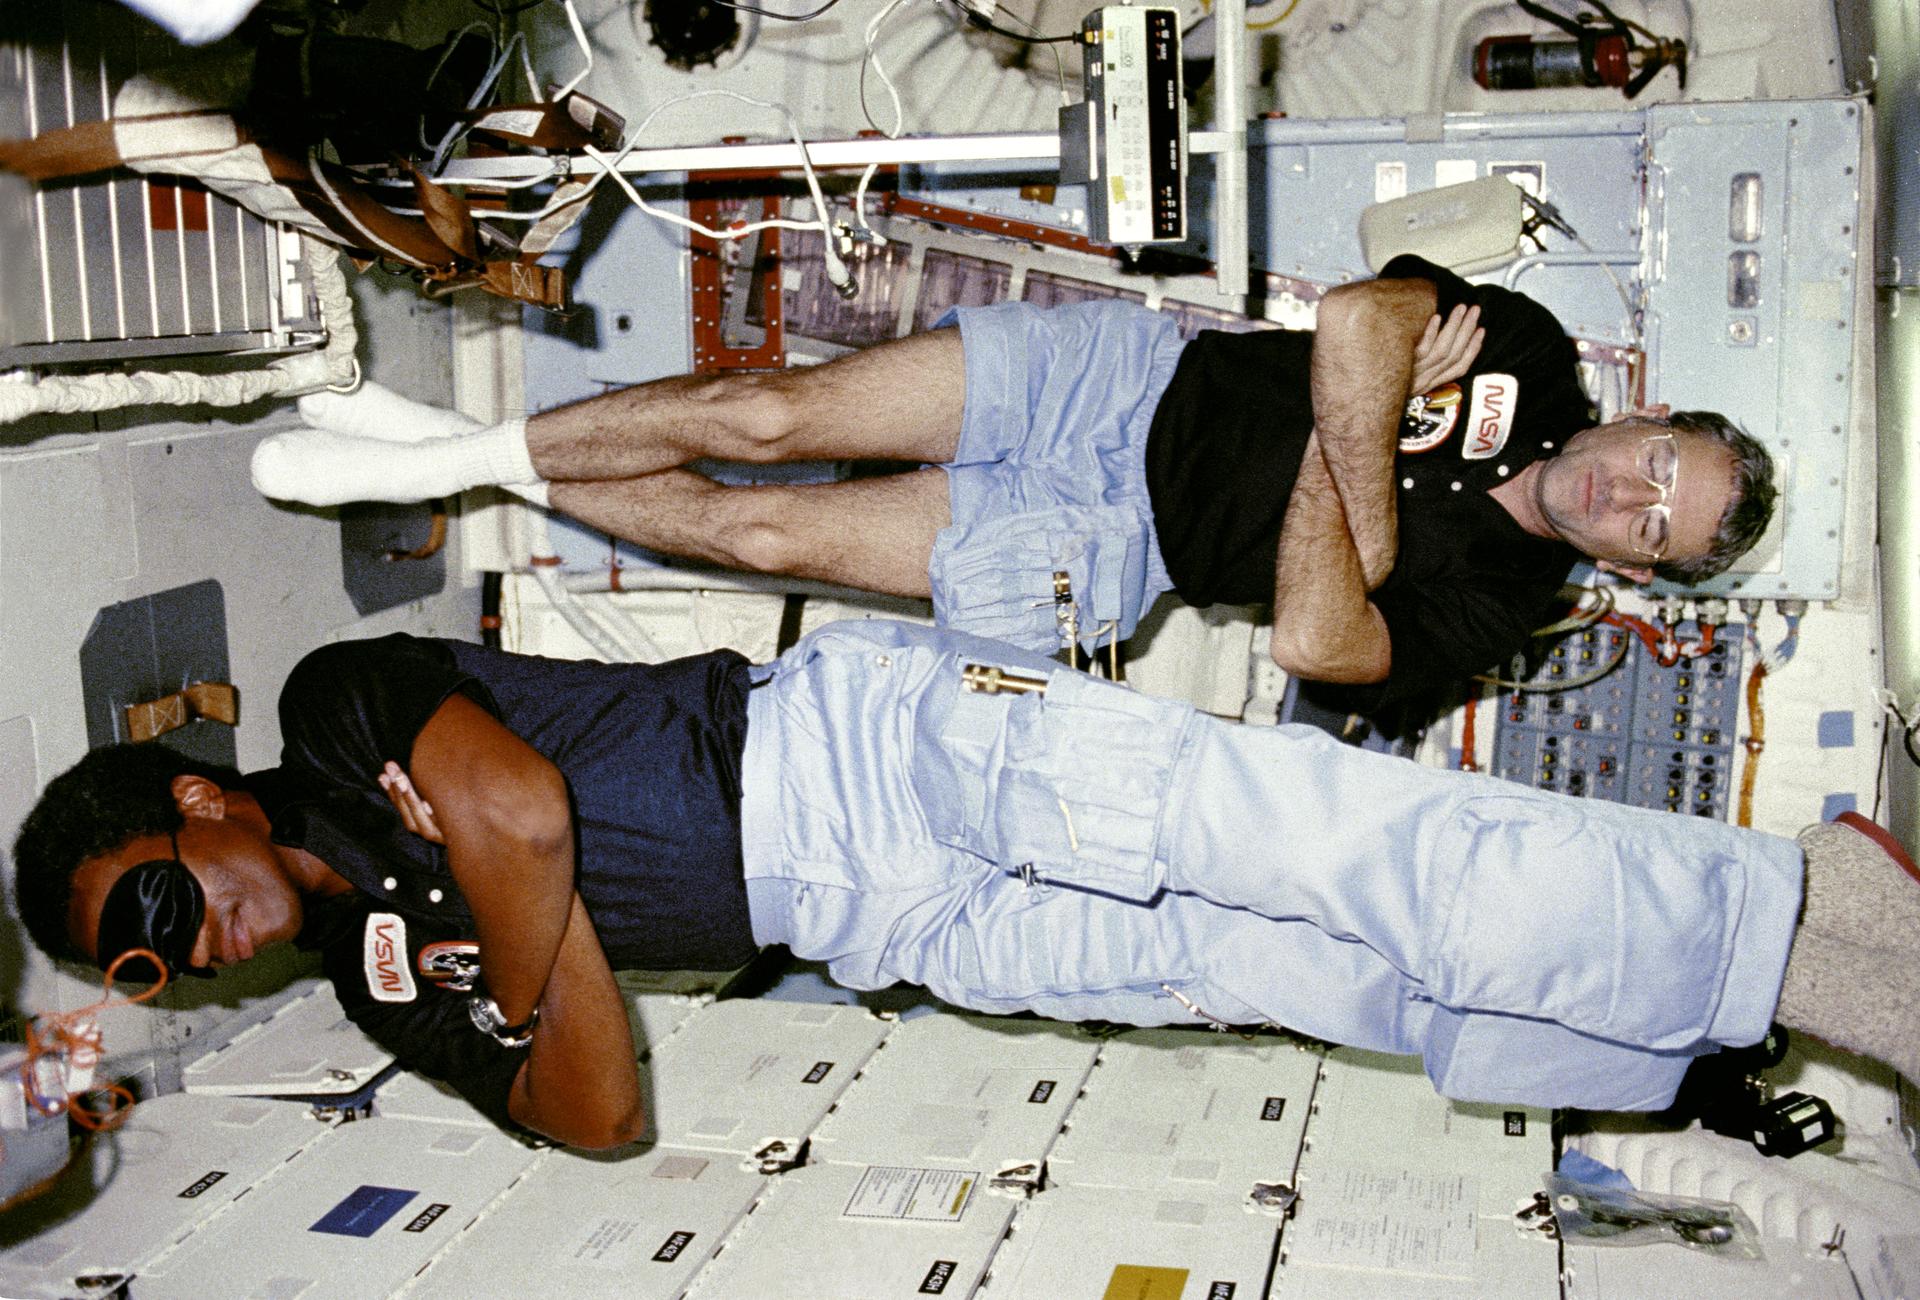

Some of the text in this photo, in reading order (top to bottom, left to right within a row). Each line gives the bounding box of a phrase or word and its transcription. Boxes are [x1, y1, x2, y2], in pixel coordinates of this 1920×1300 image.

[1472, 384, 1505, 453] NASA
[375, 923, 404, 992] NASA
[657, 1233, 689, 1260] MF43K
[924, 1262, 951, 1292] MF43H
